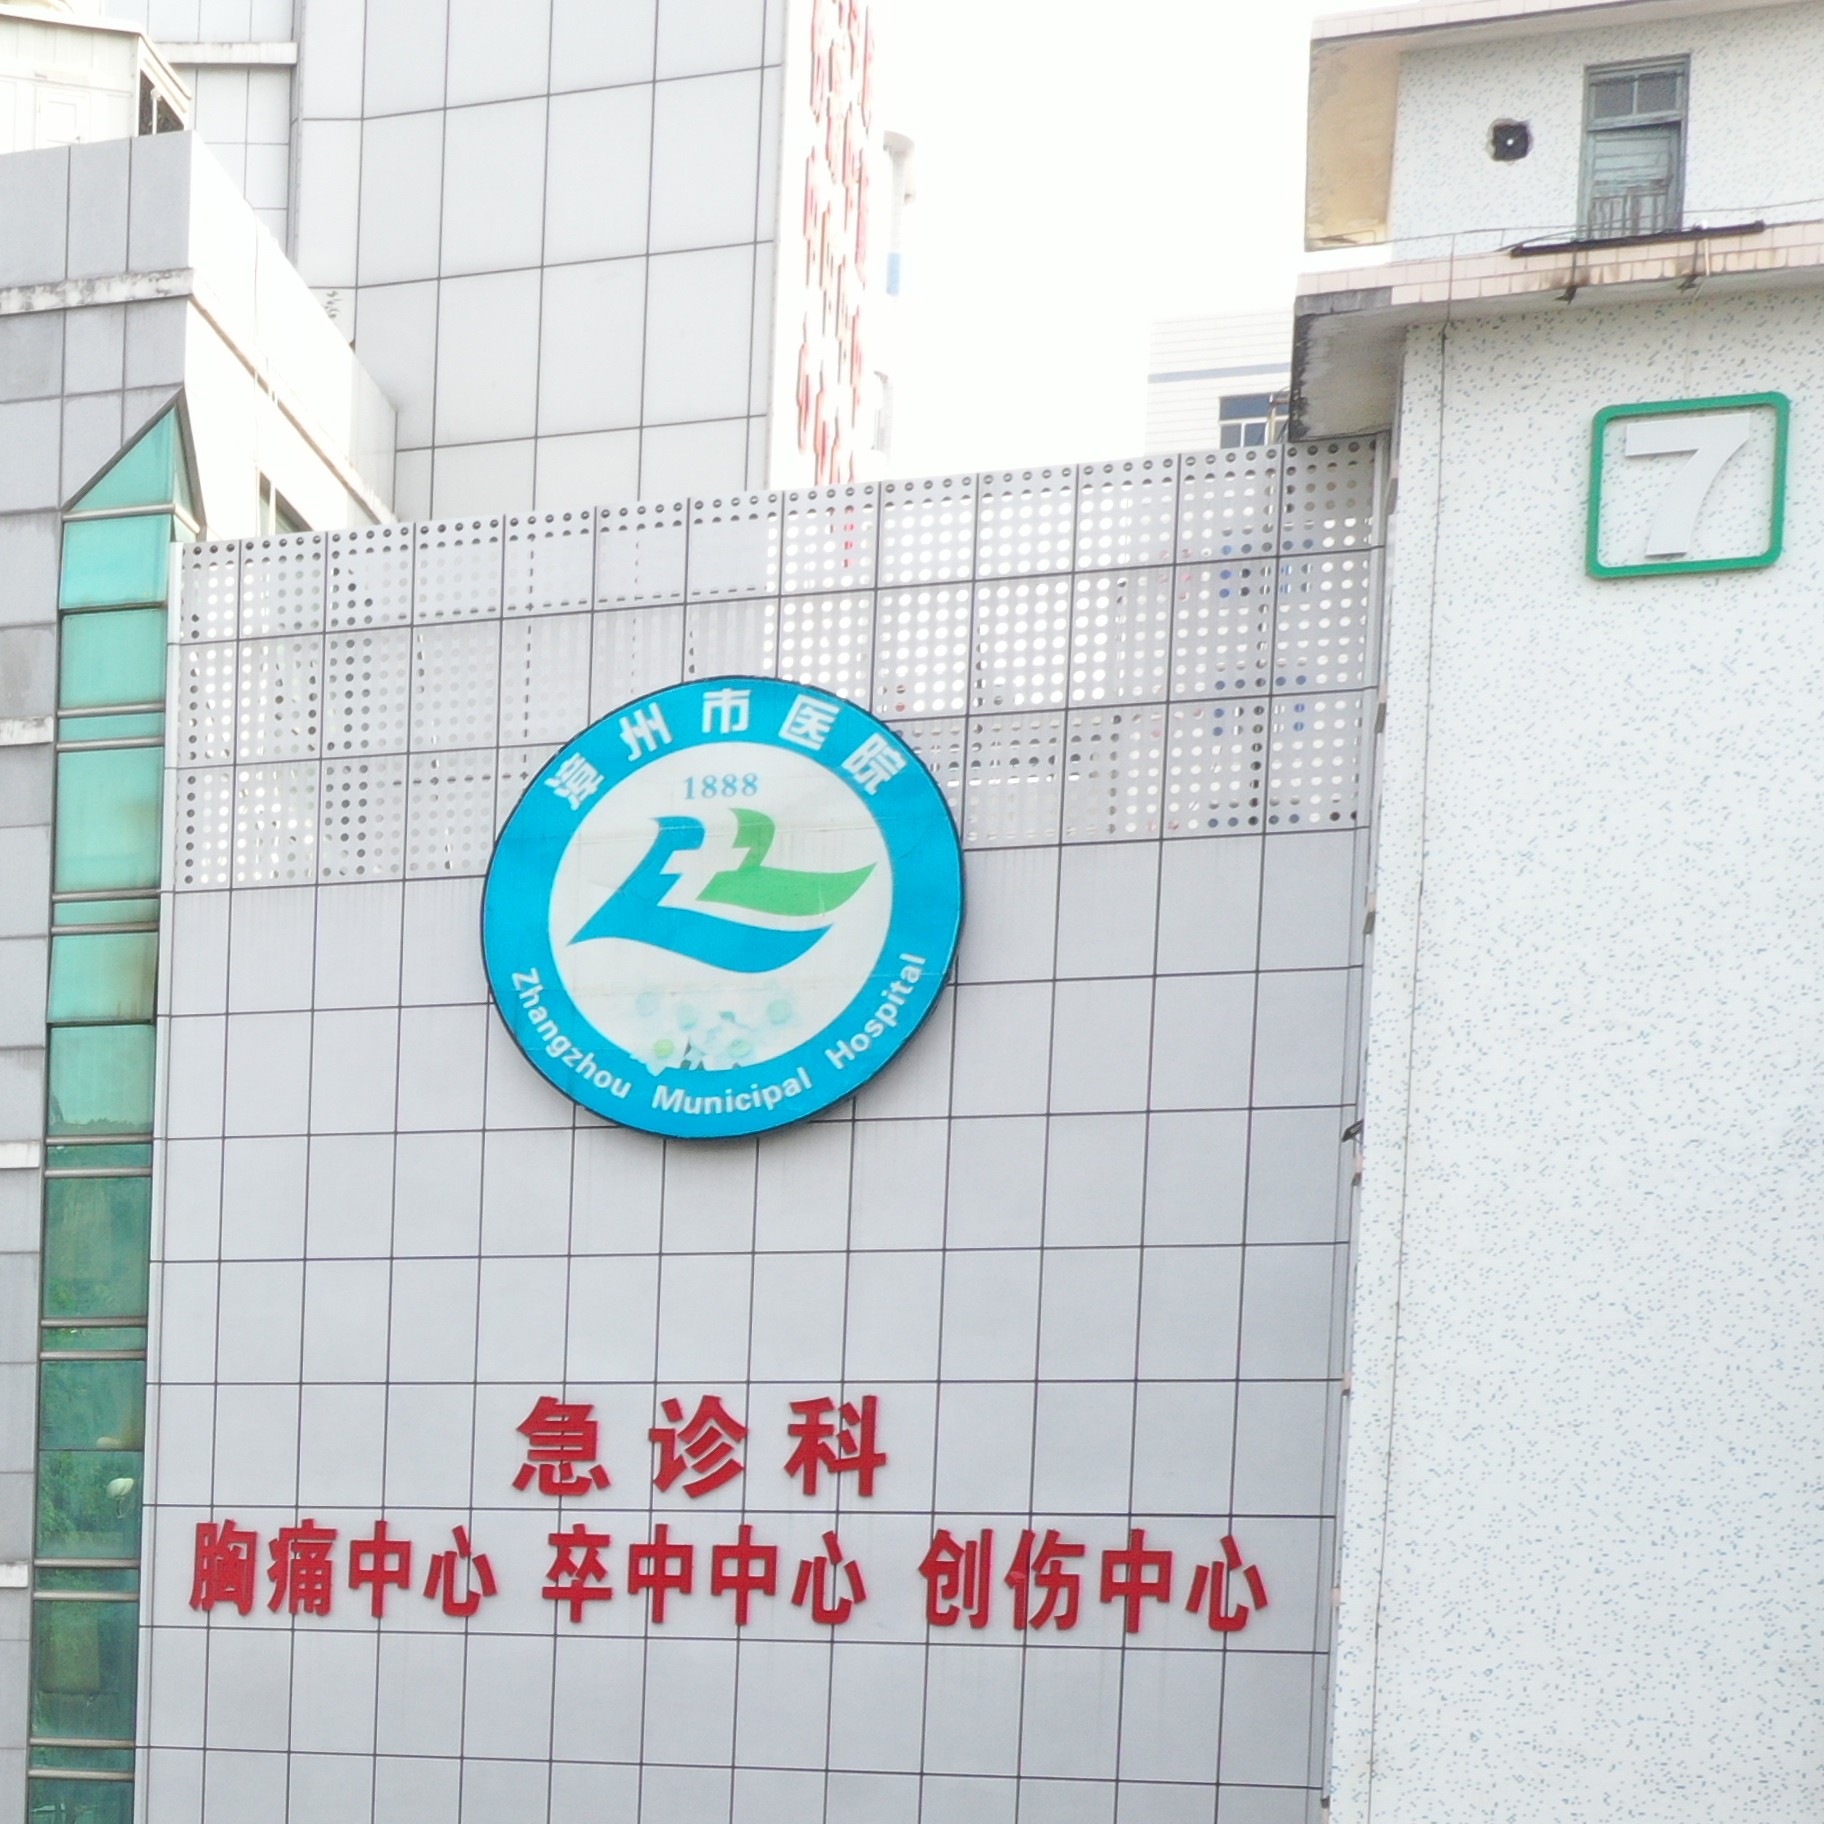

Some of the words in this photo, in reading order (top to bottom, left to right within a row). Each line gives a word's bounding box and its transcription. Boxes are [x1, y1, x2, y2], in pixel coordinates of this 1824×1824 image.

[1623, 412, 1750, 557] 7
[545, 687, 908, 810] 漳州市医院
[683, 773, 758, 800] 1888
[511, 967, 631, 1101] Zhangzhou
[652, 1067, 812, 1115] Municipal
[825, 954, 926, 1070] Hospital
[511, 1394, 886, 1498] 急诊科
[189, 1519, 498, 1619] 胸痛中心
[541, 1523, 866, 1627] 卒中中心
[917, 1528, 1269, 1634] 创伤中心
